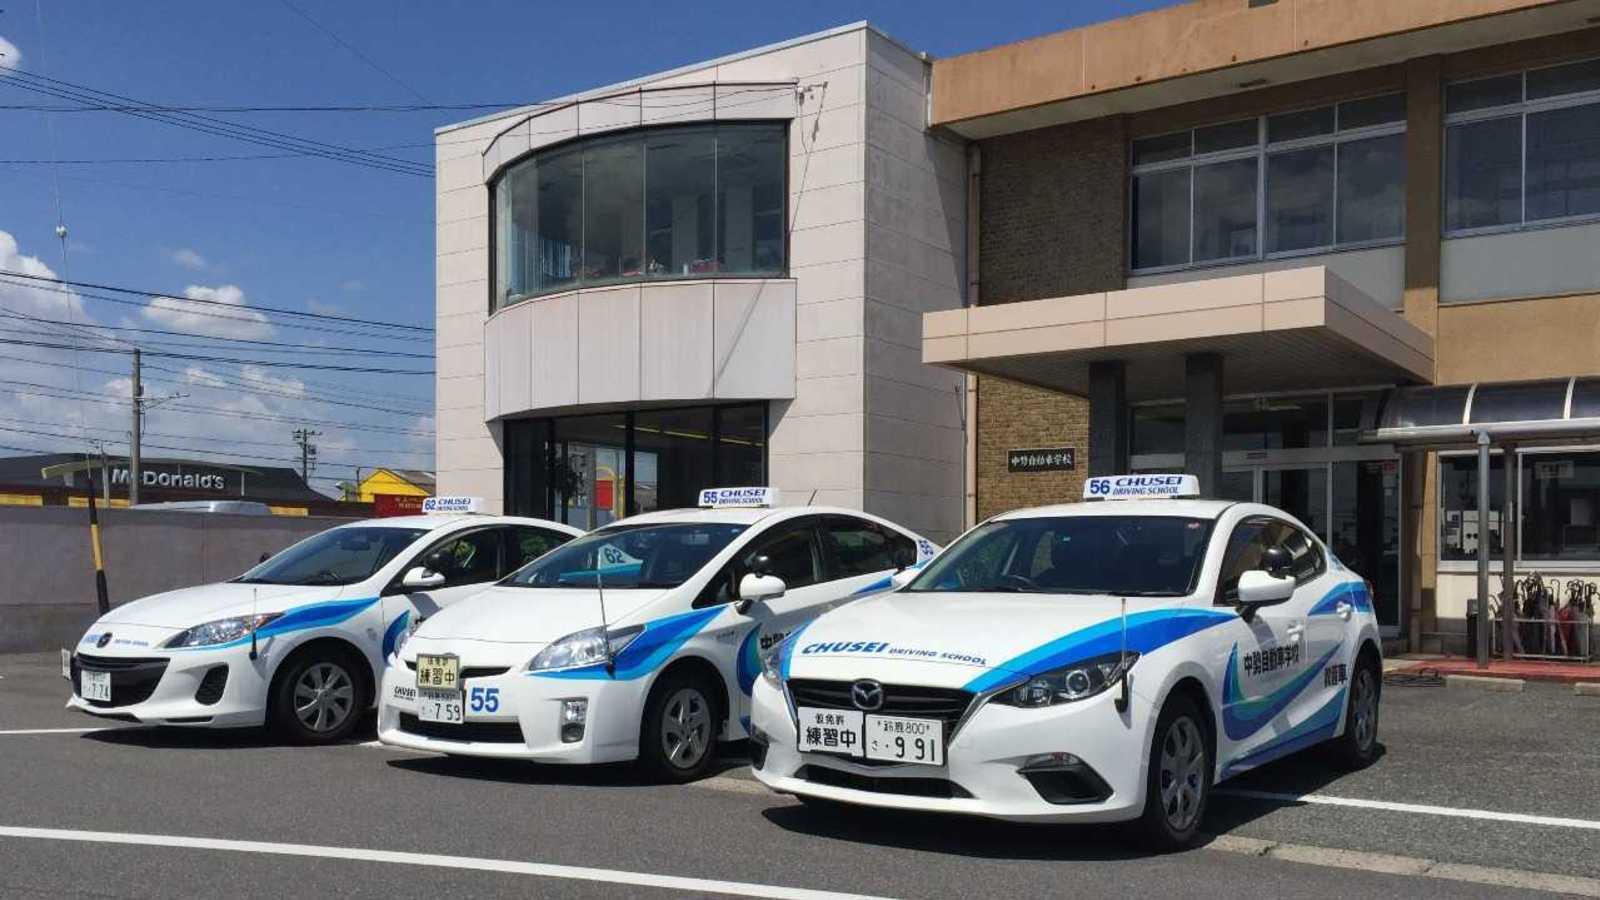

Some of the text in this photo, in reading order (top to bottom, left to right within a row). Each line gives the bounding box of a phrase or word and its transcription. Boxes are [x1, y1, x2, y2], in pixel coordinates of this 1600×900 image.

[111, 468, 225, 489] MDonald's
[1090, 476, 1183, 494] 56 CHUSEI
[703, 489, 767, 503] 55 CHUSEI
[1112, 486, 1180, 496] DRIVING SCHOOL
[424, 499, 437, 511] 62
[604, 547, 626, 563] 62
[802, 641, 988, 666] CHUSEI DRIVING SCHOOL
[420, 667, 455, 686] 練習中
[471, 687, 500, 713] 55
[806, 726, 857, 748] 練習中
